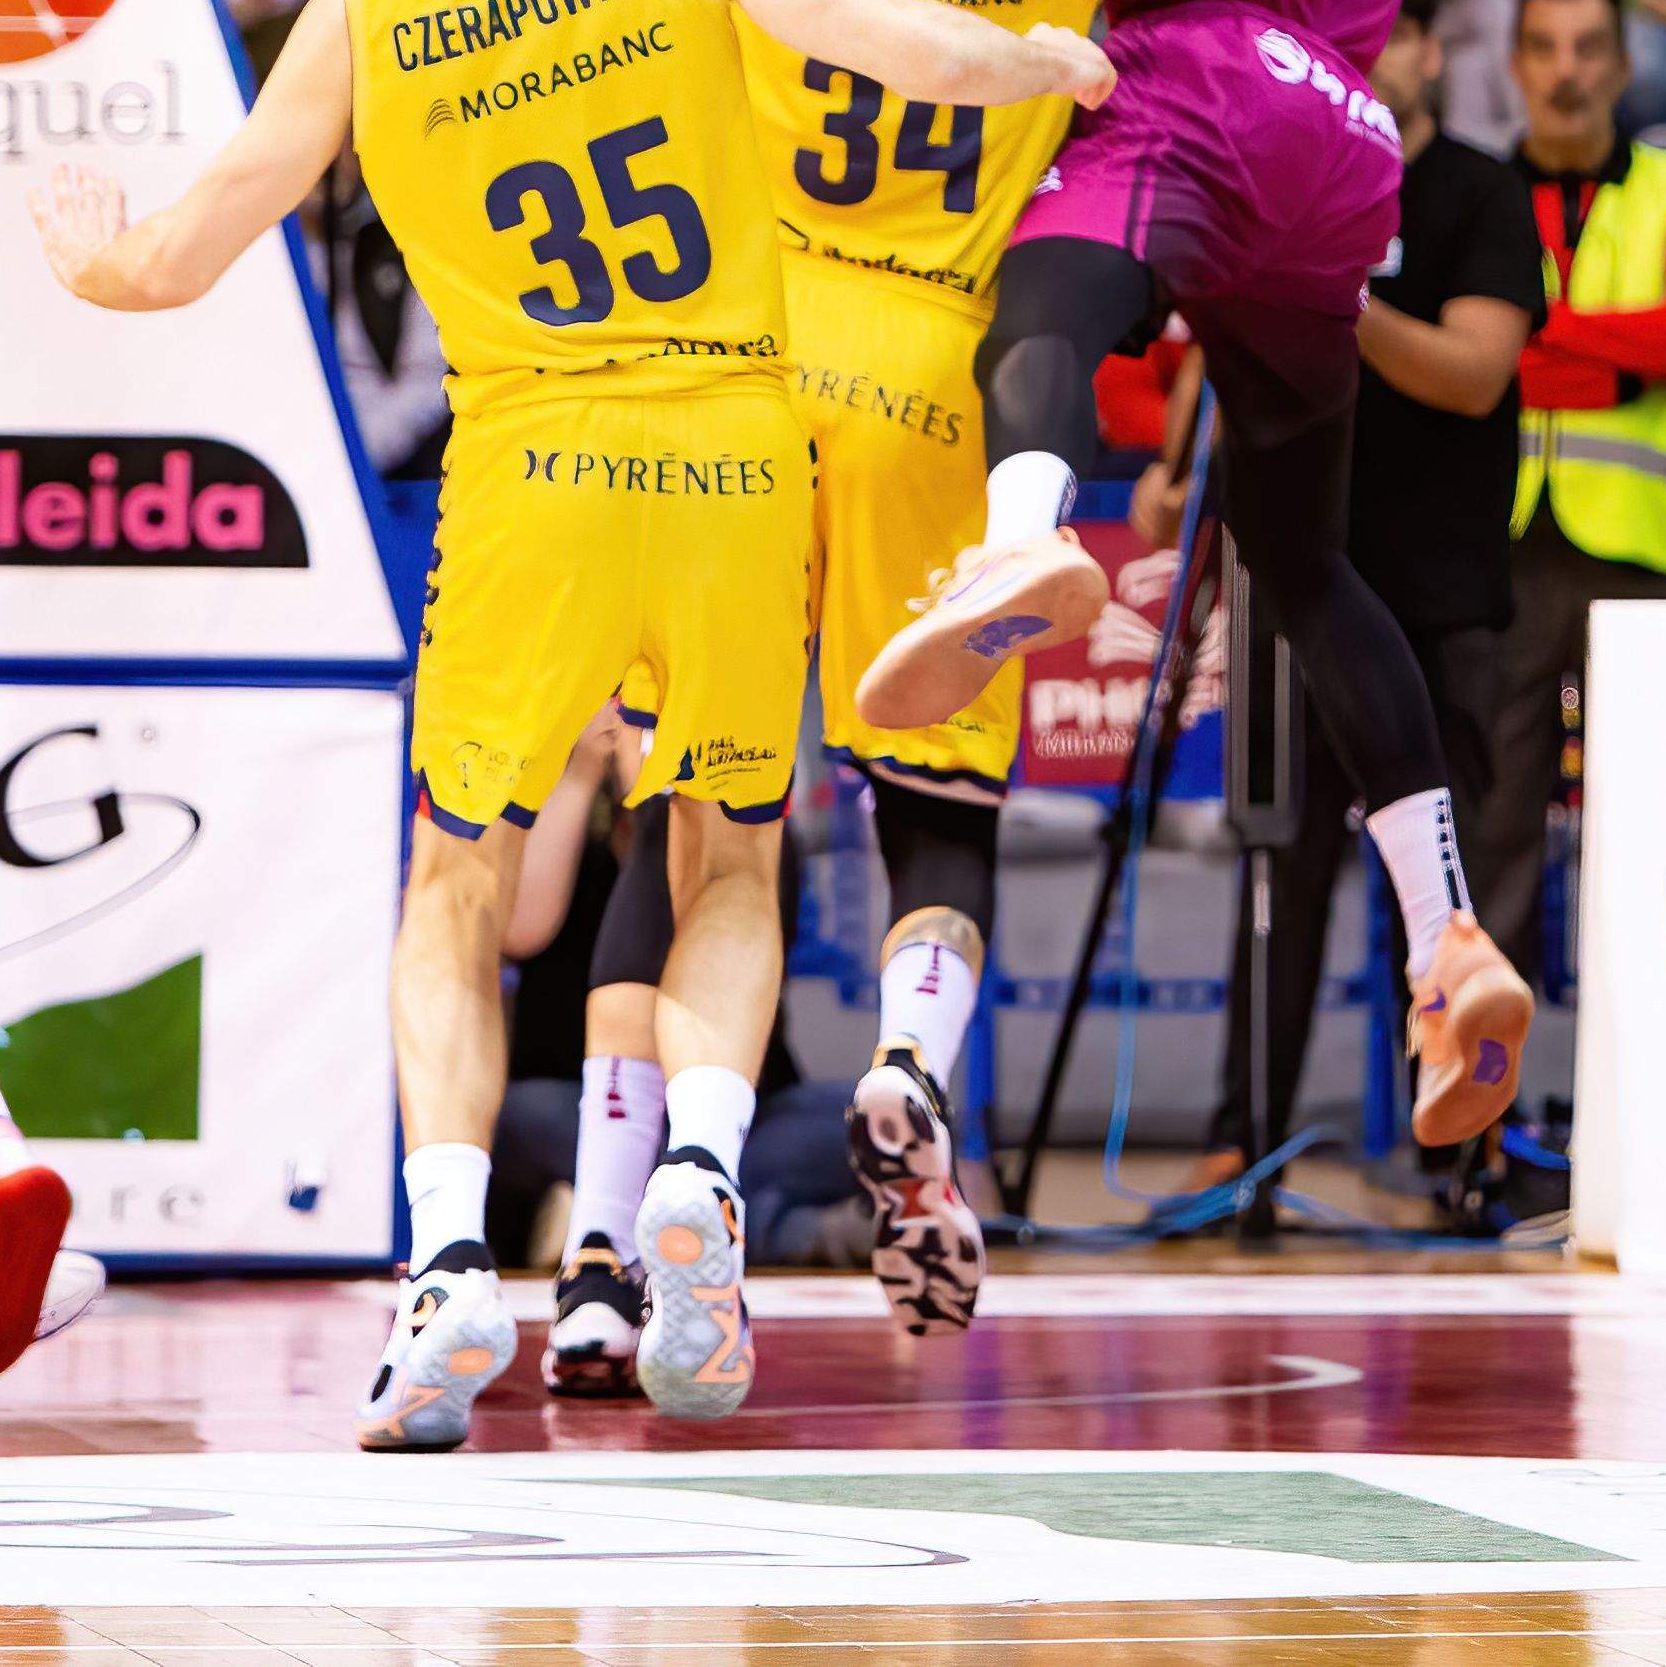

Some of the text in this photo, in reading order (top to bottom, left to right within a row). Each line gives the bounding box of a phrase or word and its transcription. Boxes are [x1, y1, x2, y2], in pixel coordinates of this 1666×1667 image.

[462, 21, 675, 123] MORABANC
[792, 58, 985, 215] 34
[484, 114, 713, 327] 35
[797, 363, 964, 447] YRÉNÉES
[573, 451, 776, 495] PYRÉNÉES
